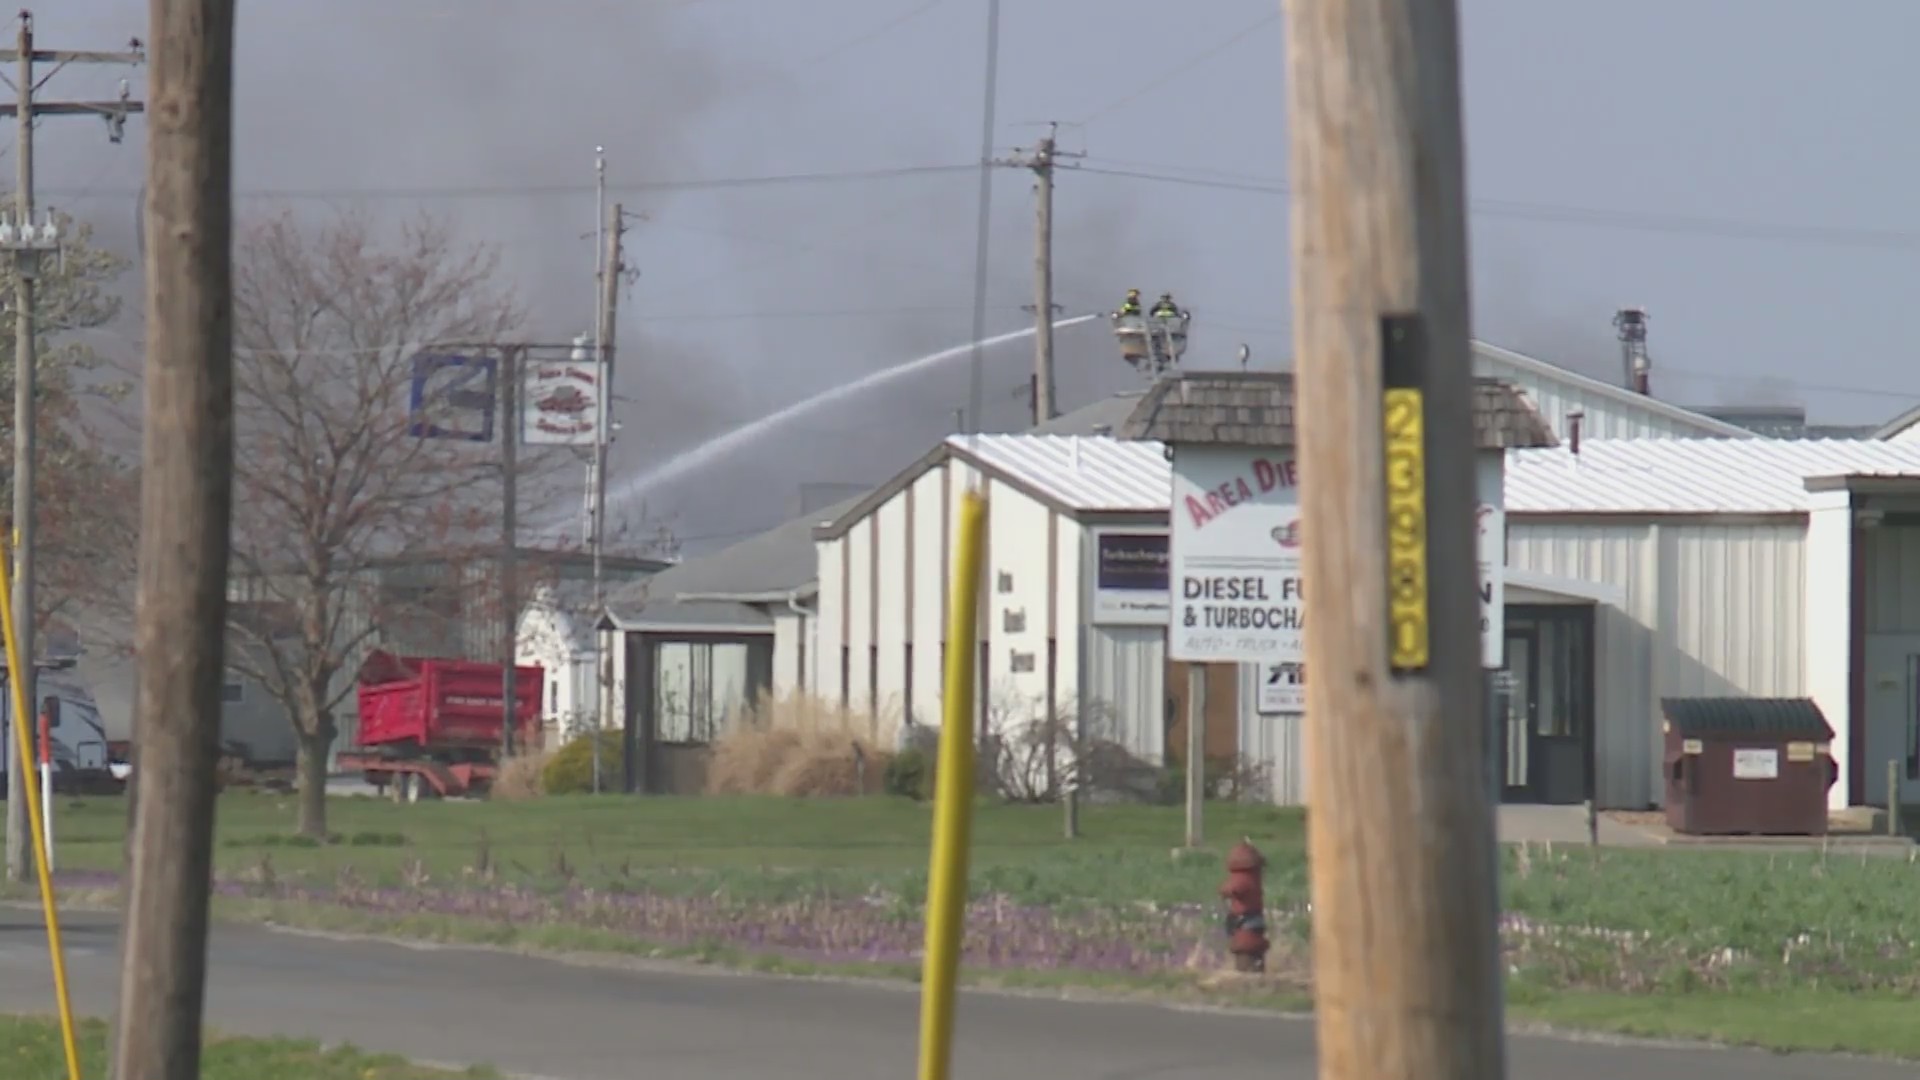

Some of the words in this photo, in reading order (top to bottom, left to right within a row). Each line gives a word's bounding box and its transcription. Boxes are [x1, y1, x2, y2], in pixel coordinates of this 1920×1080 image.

[1184, 476, 1254, 530] AREA
[1183, 576, 1269, 600] DIESEL
[1183, 604, 1198, 628] &
[1203, 605, 1305, 630] TURBOCH
